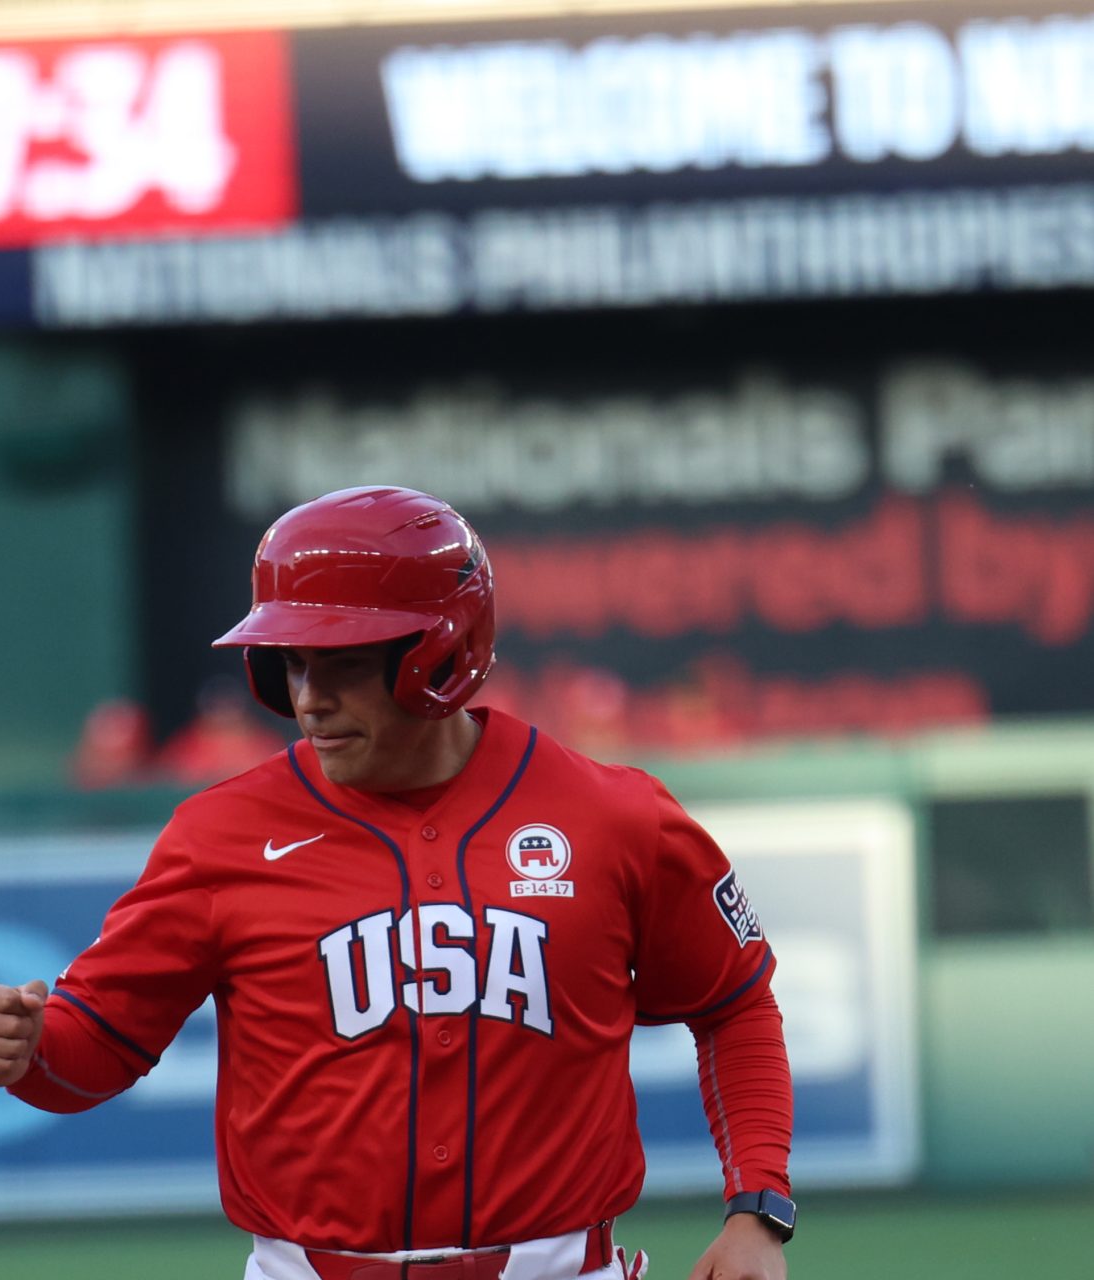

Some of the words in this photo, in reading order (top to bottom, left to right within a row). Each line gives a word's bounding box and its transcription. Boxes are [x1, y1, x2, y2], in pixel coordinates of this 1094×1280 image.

[382, 32, 830, 182] WELCOME
[832, 22, 958, 163] TO
[33, 218, 462, 328] NATIONALS
[228, 376, 868, 518] Nationals
[514, 882, 569, 895] 6-14-17
[317, 902, 554, 1041] USA
